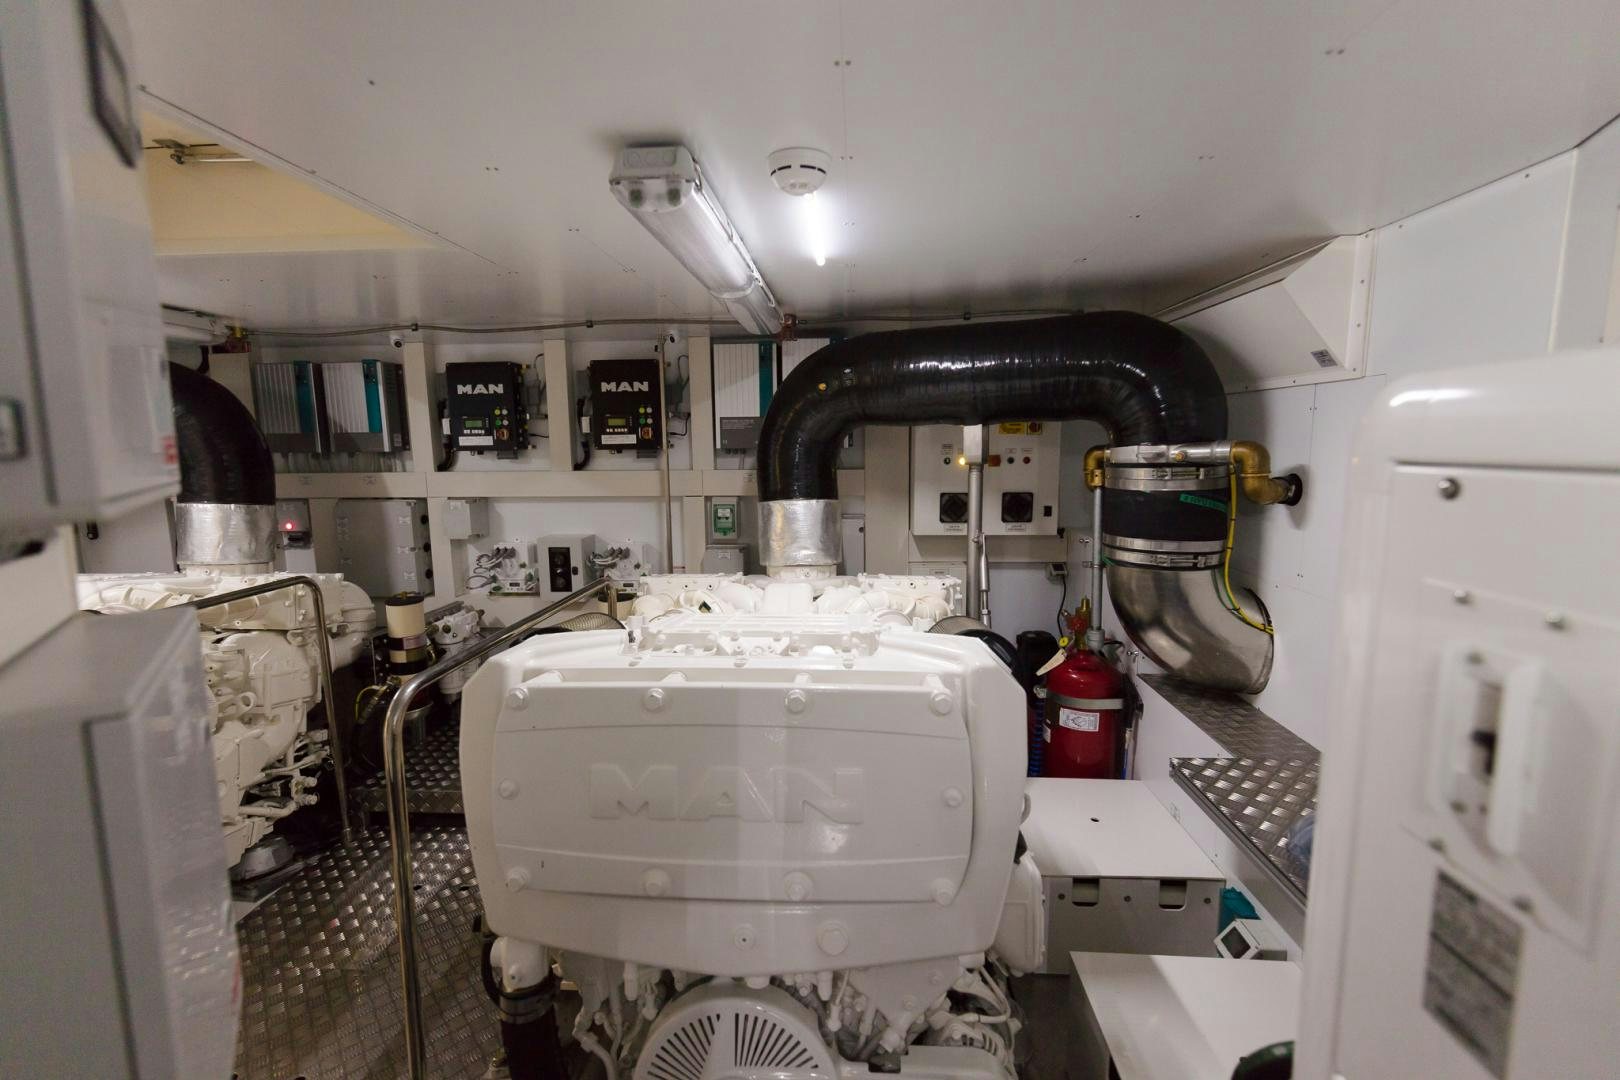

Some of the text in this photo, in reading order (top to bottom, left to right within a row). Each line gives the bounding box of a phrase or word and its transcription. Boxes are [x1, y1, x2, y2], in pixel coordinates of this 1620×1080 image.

[456, 383, 504, 395] MAN
[600, 381, 649, 393] MAN
[588, 763, 864, 825] MAN
